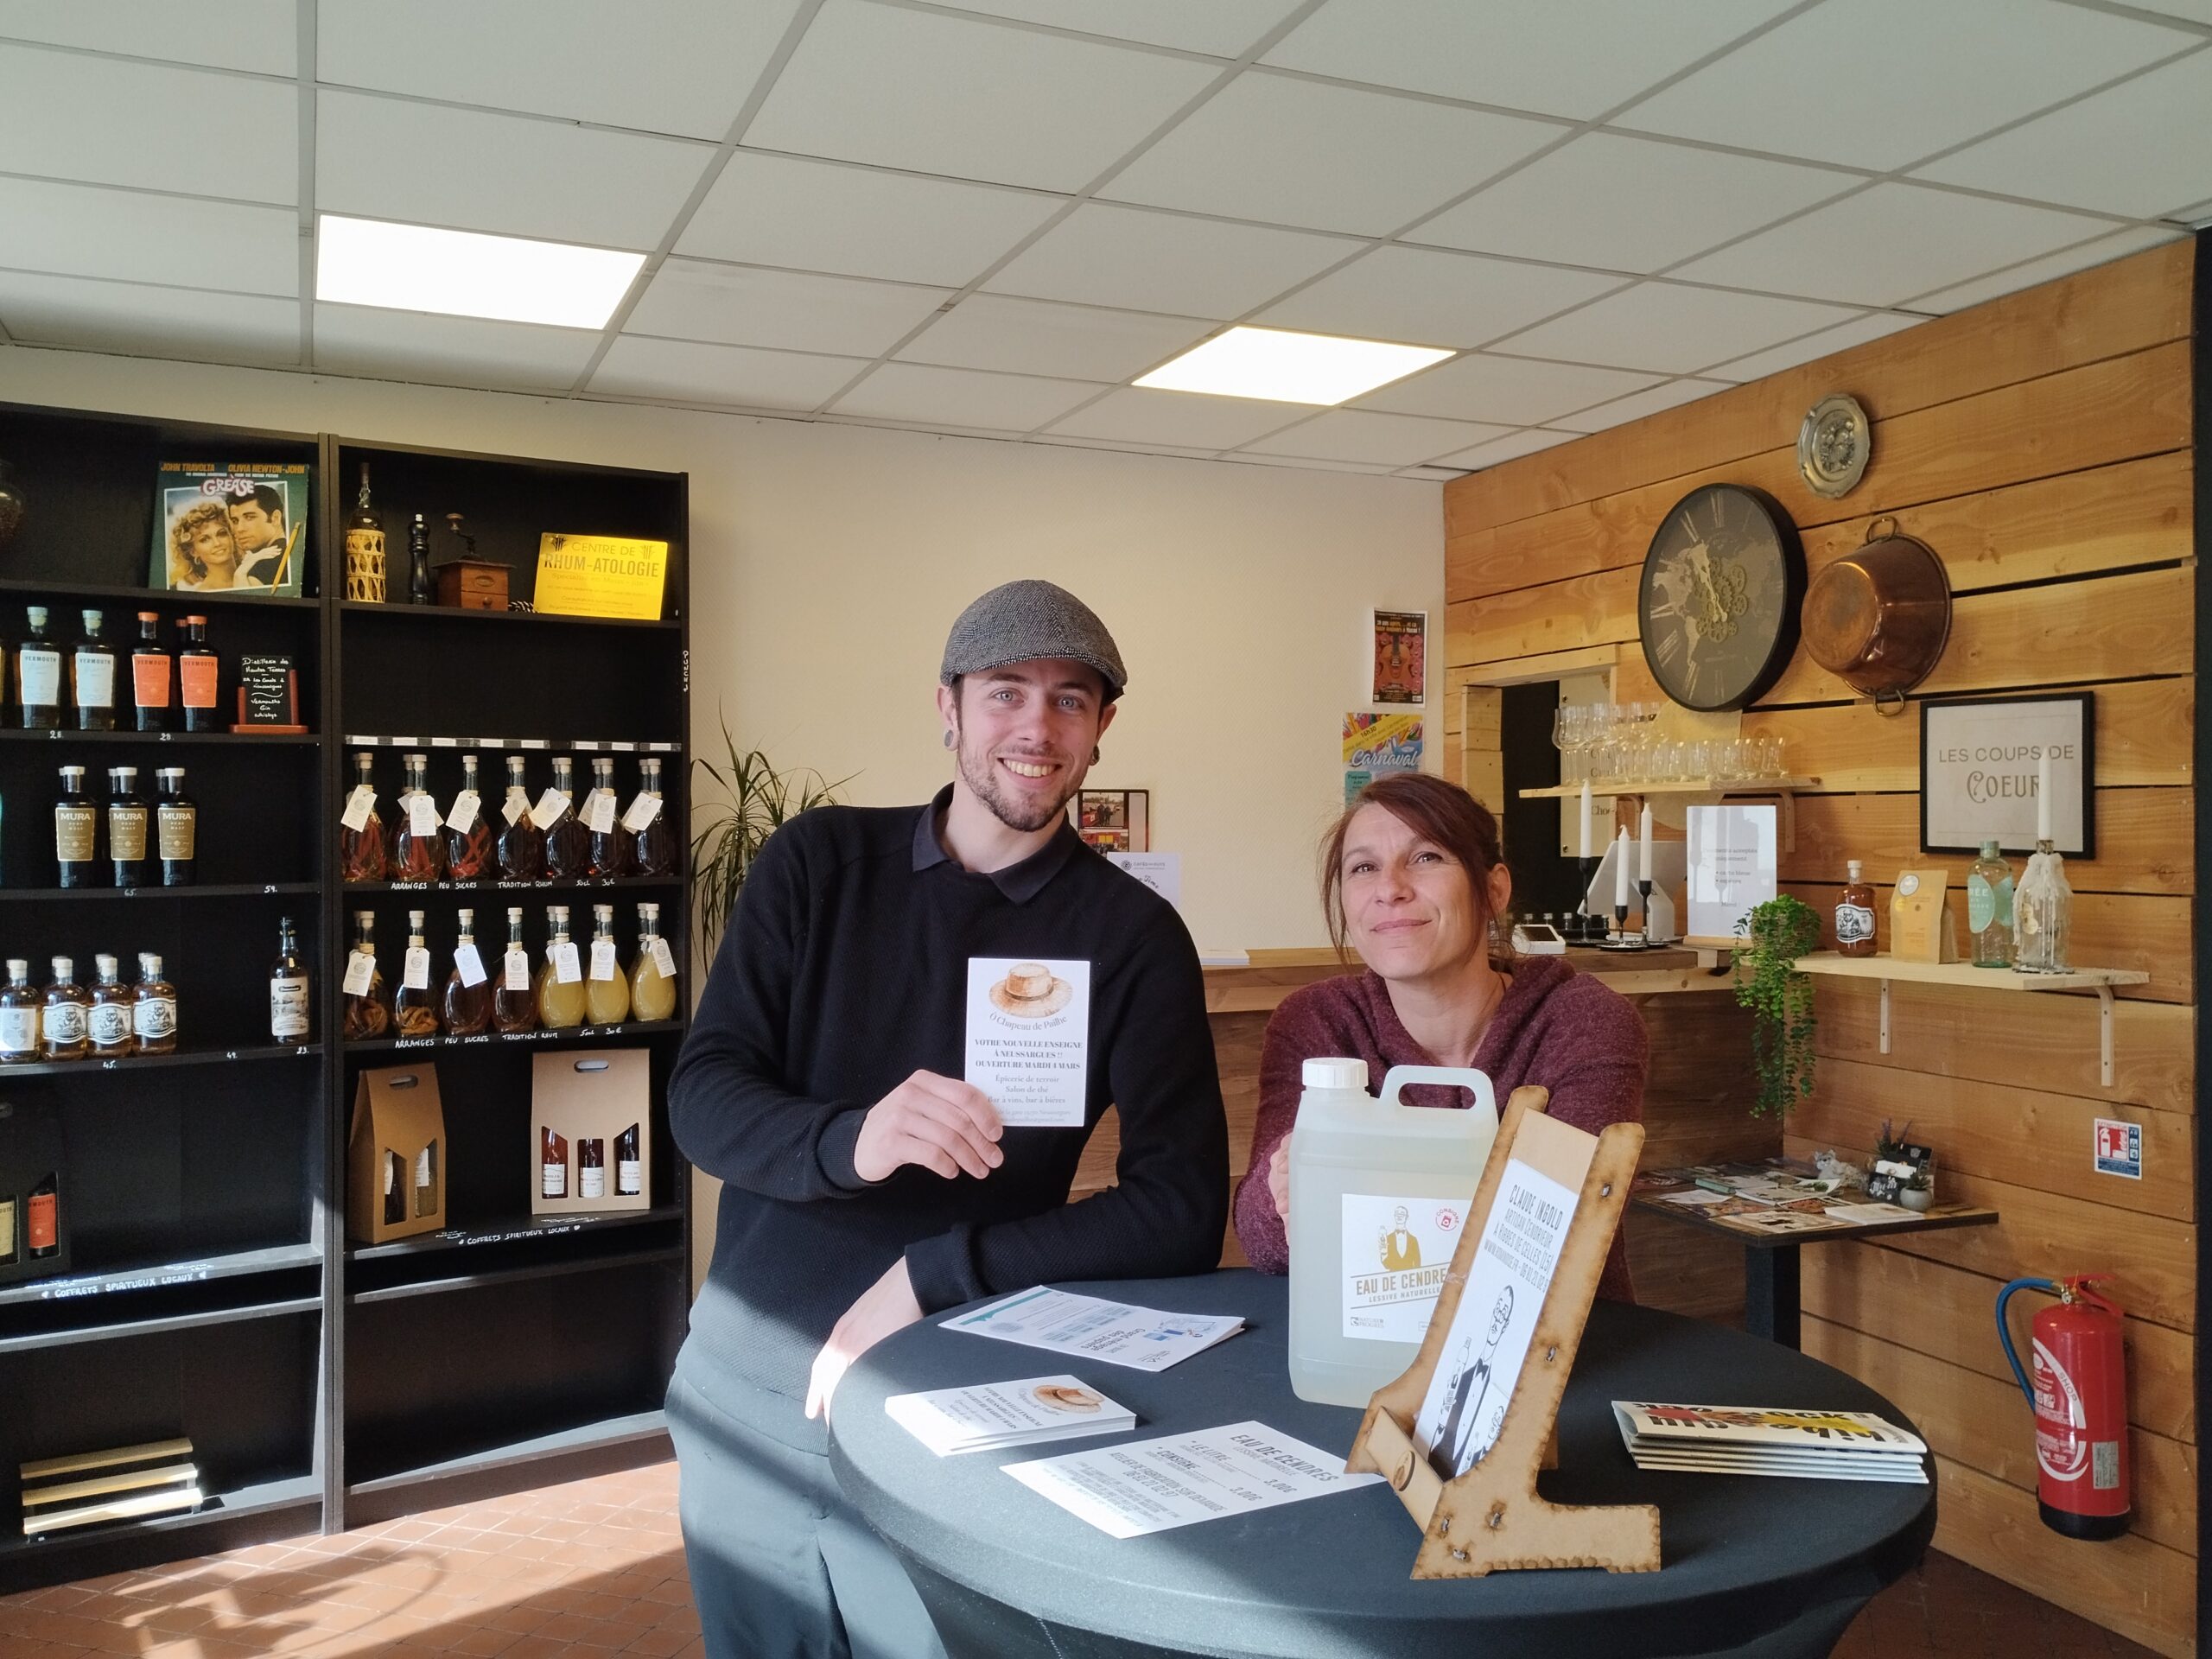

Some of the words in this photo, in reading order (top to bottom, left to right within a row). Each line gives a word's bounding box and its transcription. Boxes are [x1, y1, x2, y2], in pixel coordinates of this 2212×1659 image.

[228, 464, 251, 473] OLIVIA
[203, 474, 256, 497] GREASE
[572, 542, 615, 555] CENTRE
[620, 546, 635, 556] DE
[543, 553, 660, 577] RHUM-ATOLOGIE
[1351, 748, 1418, 768] Carnaval
[1939, 748, 1969, 763] LES
[1975, 746, 2042, 762] COUPS
[2049, 745, 2074, 760] DE
[60, 812, 91, 821] MURA
[113, 812, 143, 821] MURA
[997, 1016, 1031, 1031] Chapeau
[395, 1039, 435, 1048] ARRANGES
[1510, 1185, 1536, 1215] CLAUDE
[1535, 1199, 1563, 1230] INGOLD
[467, 1234, 501, 1244] COFFRETS
[506, 1229, 543, 1240] SPIRITUEUX
[548, 1225, 569, 1235] LOCAUX
[1521, 1241, 1542, 1266] CELLES
[54, 1285, 98, 1298] COFFRETS
[105, 1277, 156, 1292] SPIRITUEUX
[162, 1273, 193, 1284] LOCAUX
[1356, 1278, 1377, 1295] EAU
[1382, 1275, 1396, 1292] DE
[1402, 1268, 1446, 1289] CENDRE
[1370, 1294, 1397, 1303] LESSIVE
[1401, 1287, 1440, 1298] NATURELLE
[1157, 1450, 1198, 1469] CONSIGNE
[1202, 1449, 1230, 1460] LITRE
[1230, 1434, 1260, 1448] EAU
[1257, 1445, 1277, 1457] DE
[1274, 1453, 1339, 1482] CENDRES
